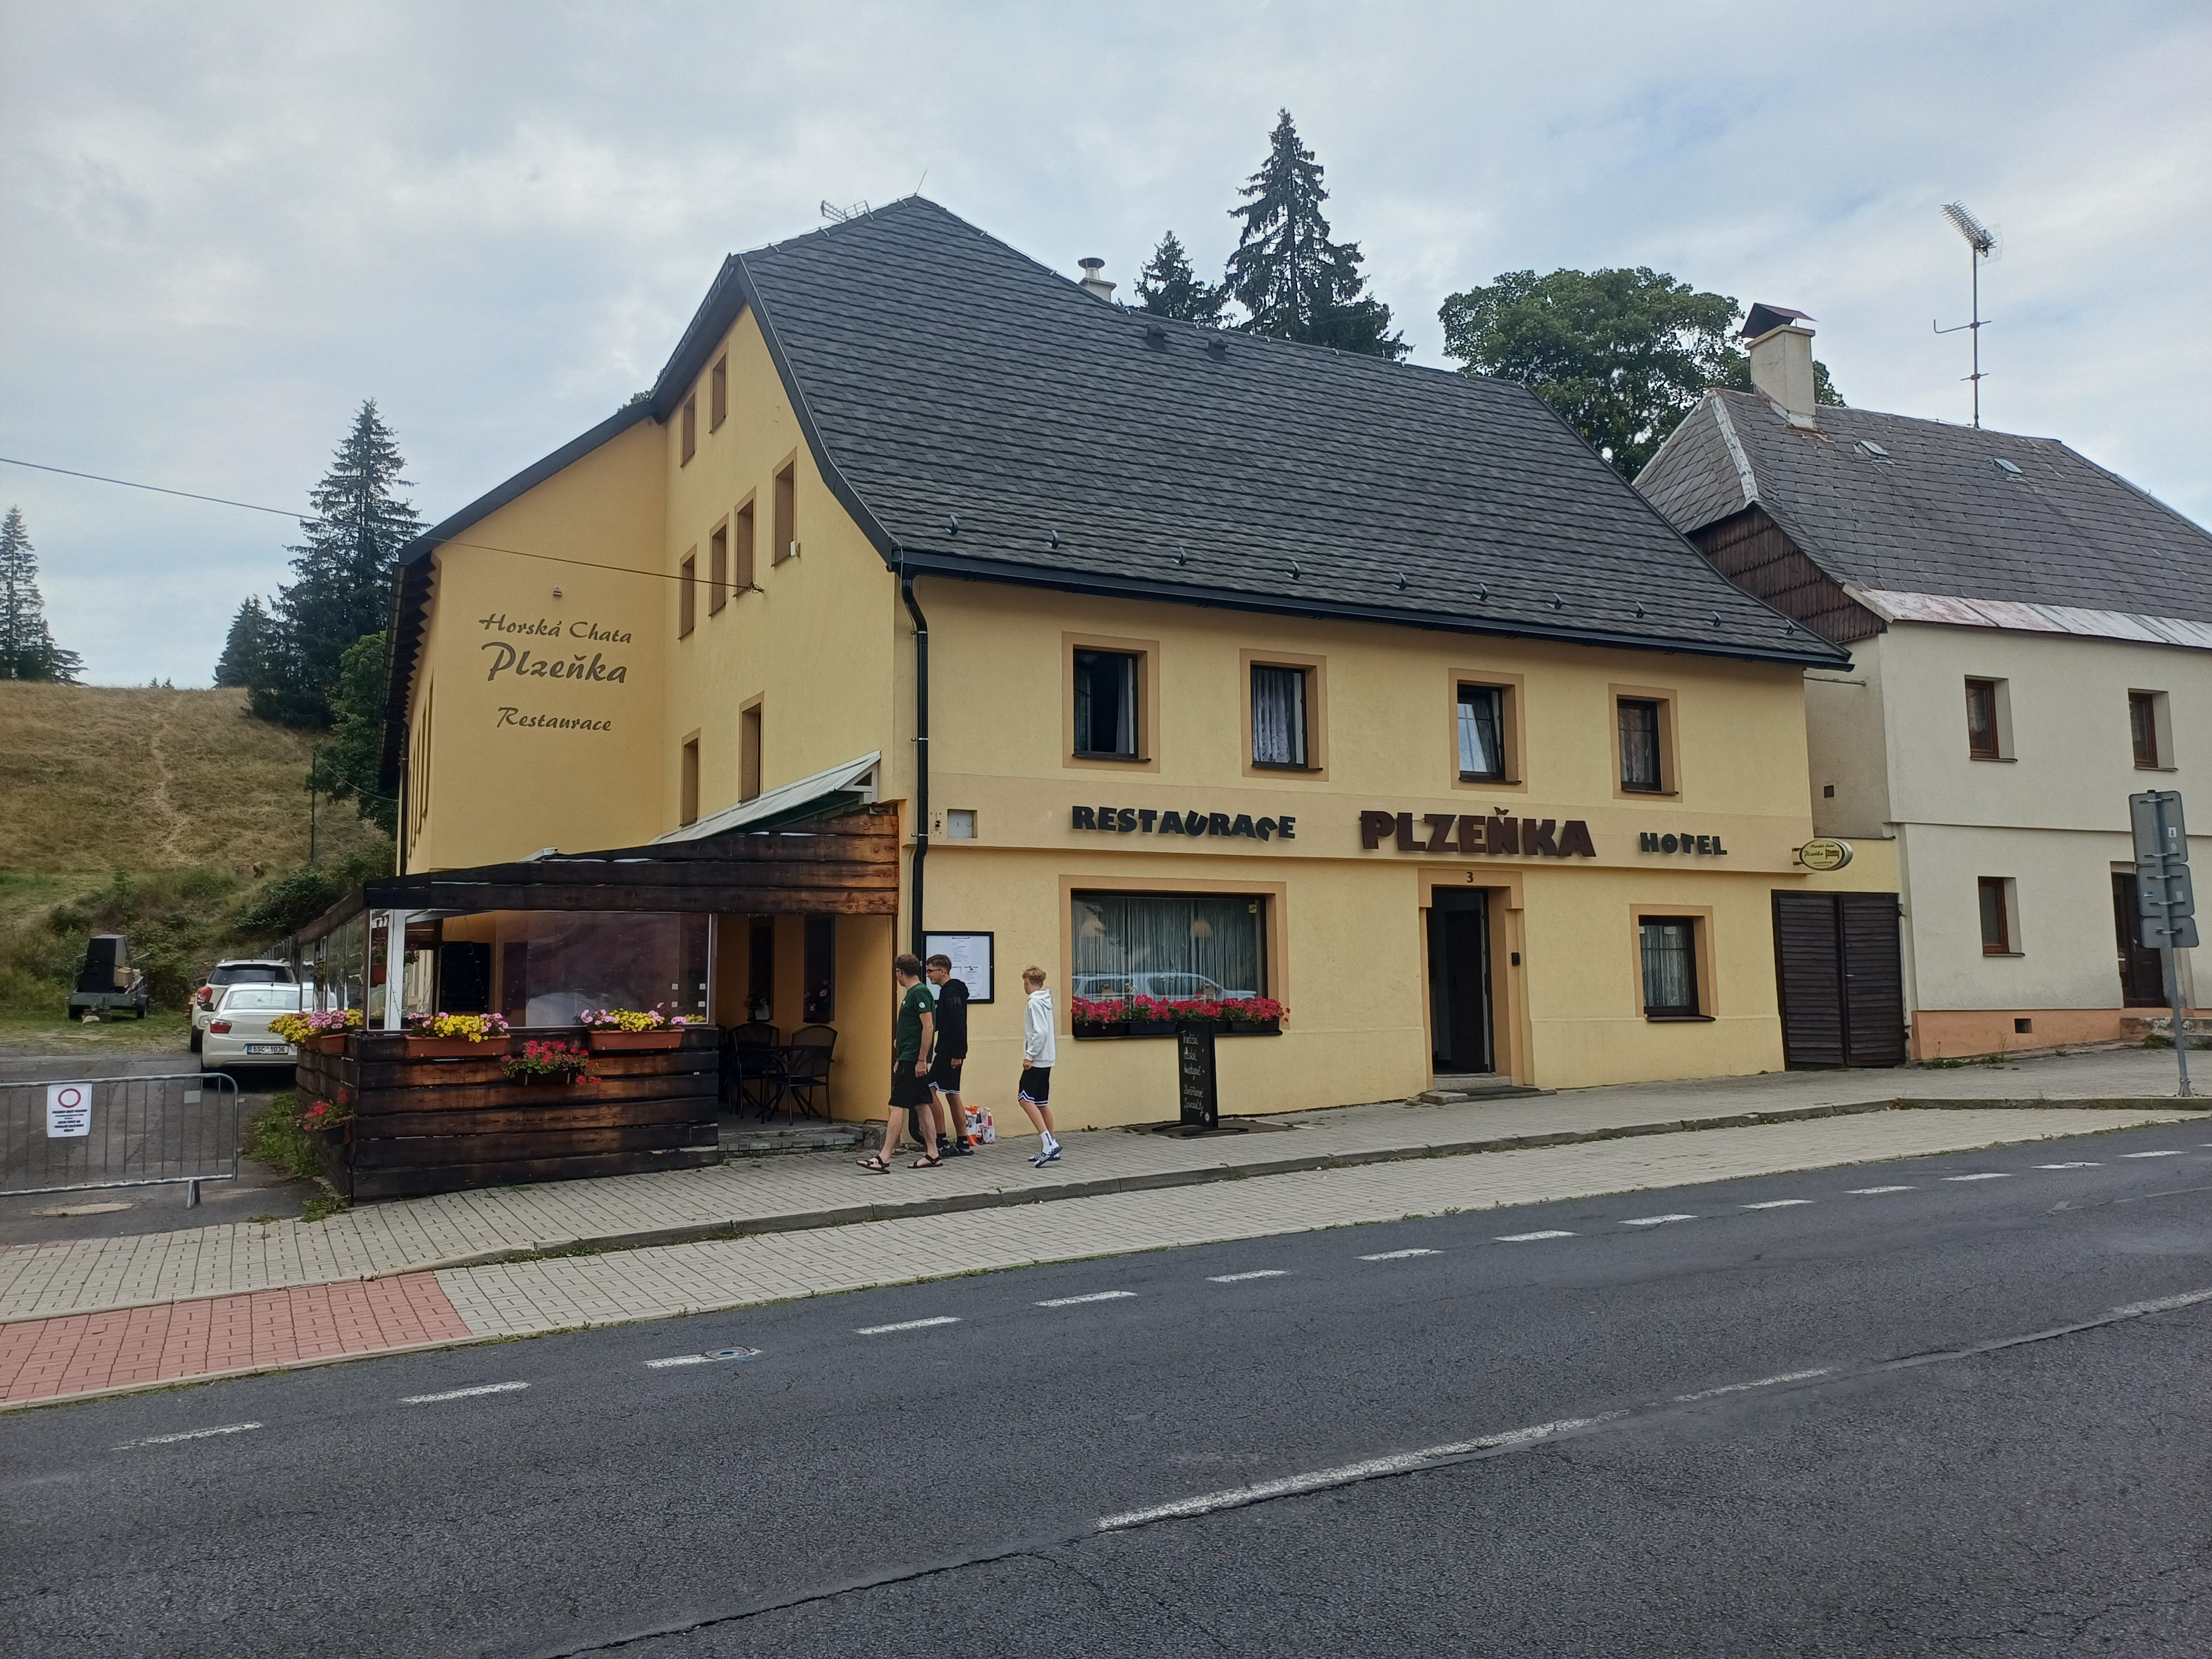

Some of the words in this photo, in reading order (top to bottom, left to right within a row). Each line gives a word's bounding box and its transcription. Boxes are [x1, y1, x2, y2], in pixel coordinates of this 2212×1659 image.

[479, 613, 562, 637] Horská
[569, 622, 632, 643] Chata
[481, 641, 627, 684] Plzeňka
[497, 707, 612, 731] Restaurace
[1072, 806, 1296, 842] RESTAURACE
[1360, 806, 1597, 857] PLZEŇKA
[1640, 832, 1728, 855] HOTEL
[1466, 872, 1474, 883] 3
